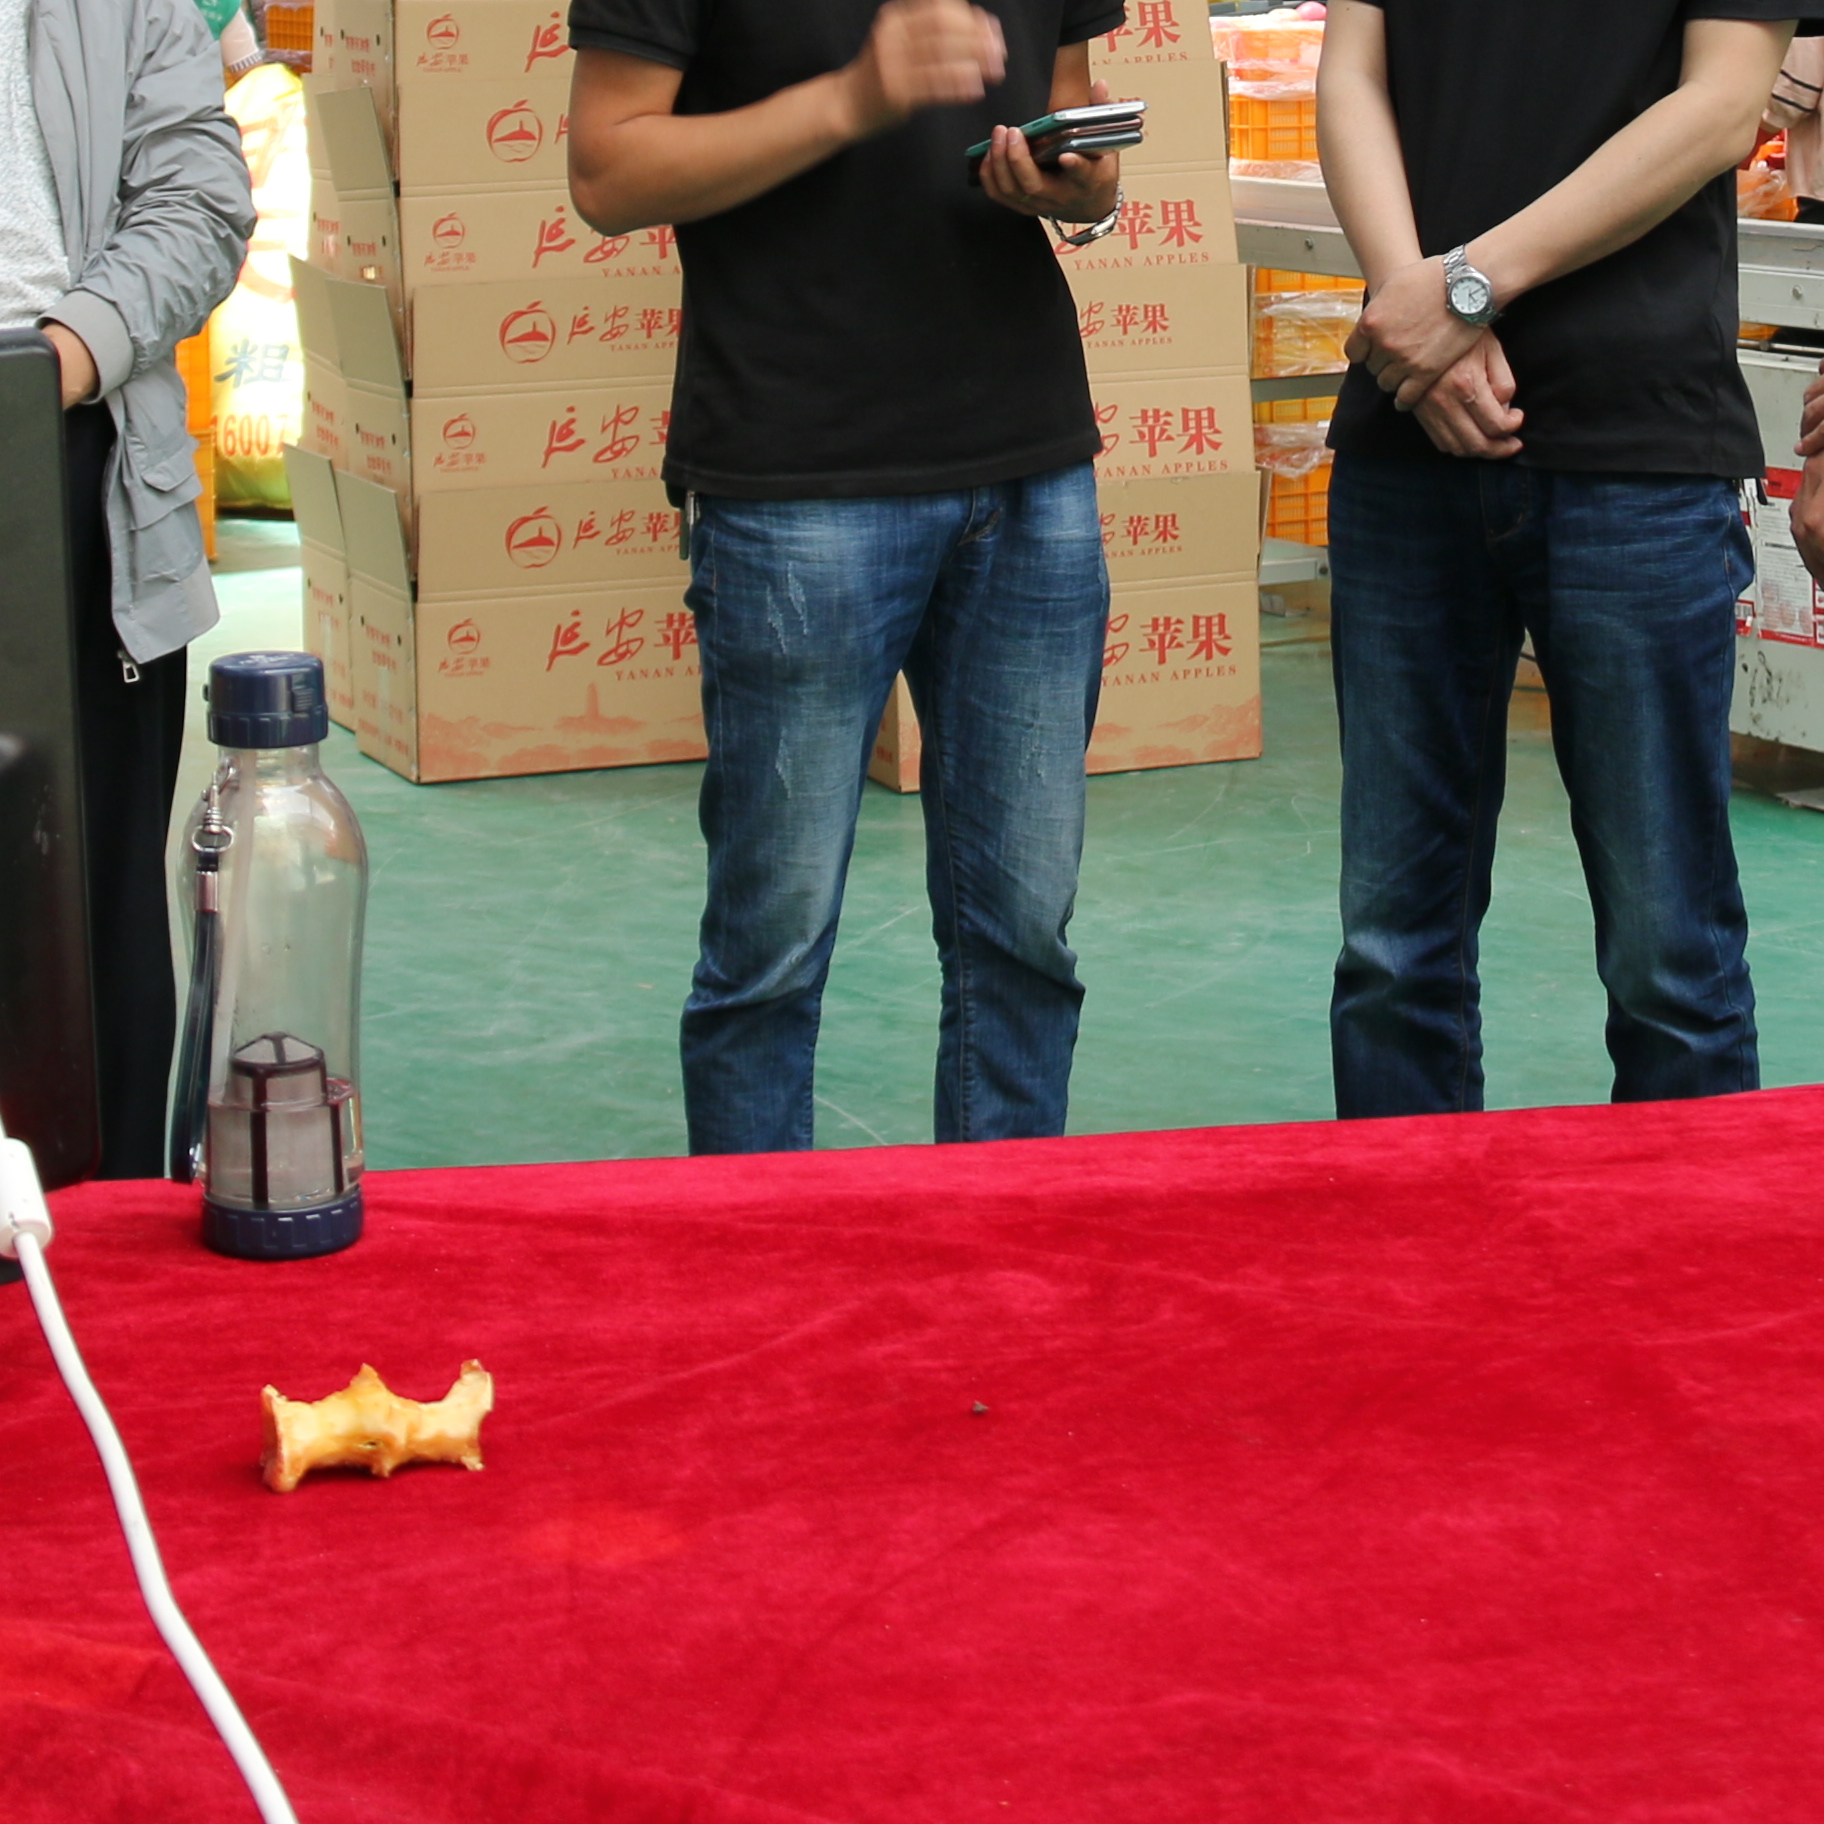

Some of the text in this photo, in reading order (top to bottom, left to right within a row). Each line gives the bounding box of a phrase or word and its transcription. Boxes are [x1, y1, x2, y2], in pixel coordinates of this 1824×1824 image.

[1074, 252, 1210, 271] YANAN APPLES
[1087, 336, 1173, 349] YANAN APPLES
[1162, 459, 1229, 474] APPLES
[1140, 546, 1183, 556] APPLES
[615, 667, 674, 681] YANAN
[1102, 664, 1237, 687] YANAN APPLES
